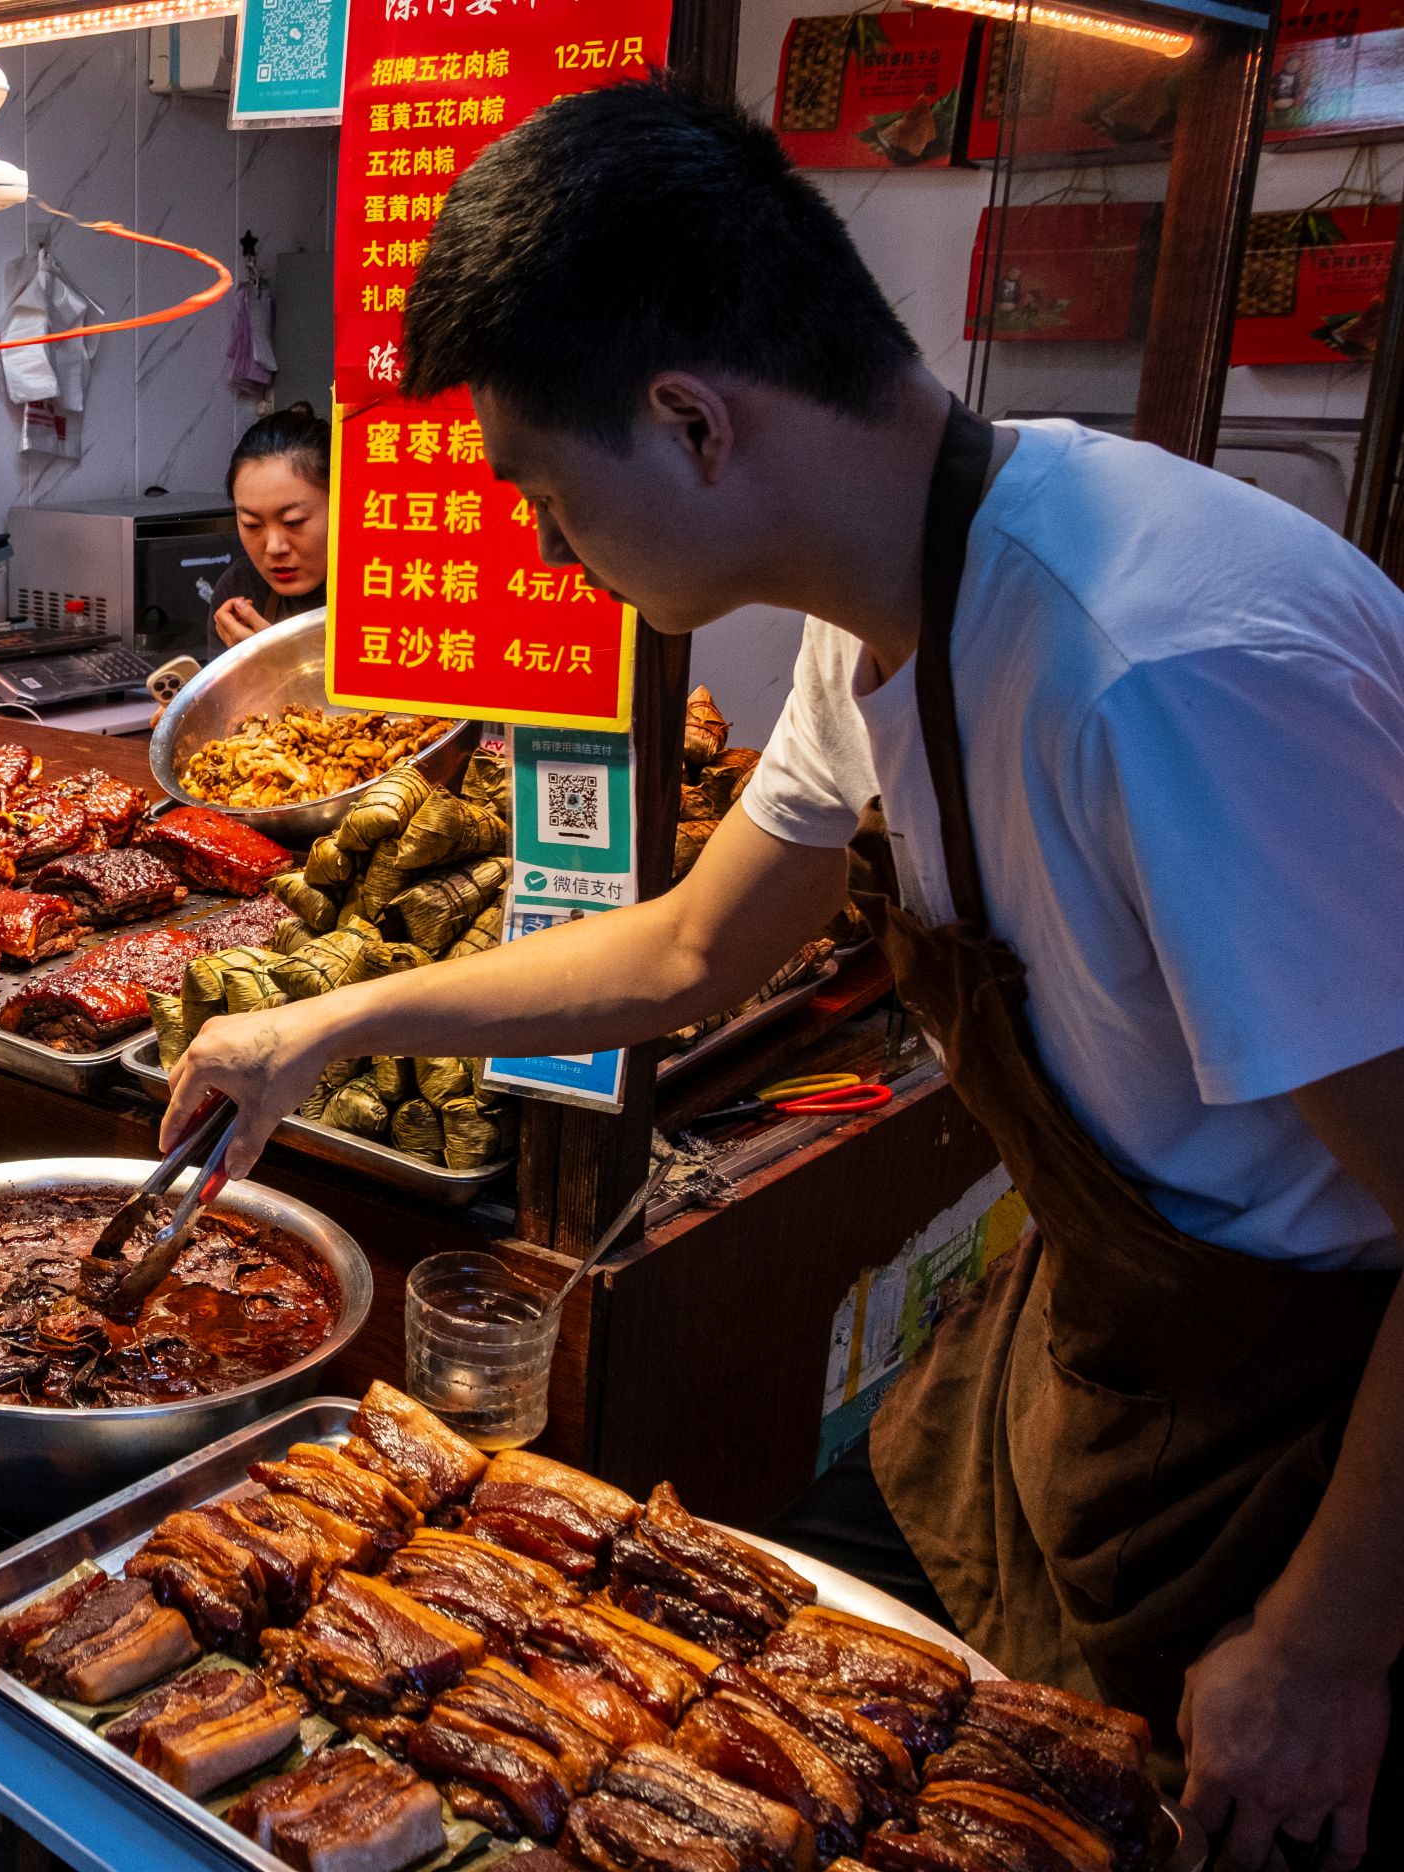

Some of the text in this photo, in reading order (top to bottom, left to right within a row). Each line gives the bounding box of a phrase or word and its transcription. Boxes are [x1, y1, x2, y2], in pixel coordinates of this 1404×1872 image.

[371, 36, 644, 86] 招牌五花肉粽 12元/只
[369, 96, 505, 132] 蛋黄五花肉粽
[365, 146, 455, 177] 五花肉粽
[361, 284, 406, 312] 扎肉
[366, 419, 484, 465] 蜜枣粽
[363, 490, 482, 534] 红豆粽
[363, 556, 597, 604] 白米粽 4元/只
[359, 625, 593, 675] 豆沙粽 4元/只
[531, 740, 612, 756] 推荐使用微信支付
[553, 875, 624, 900] 微信支付
